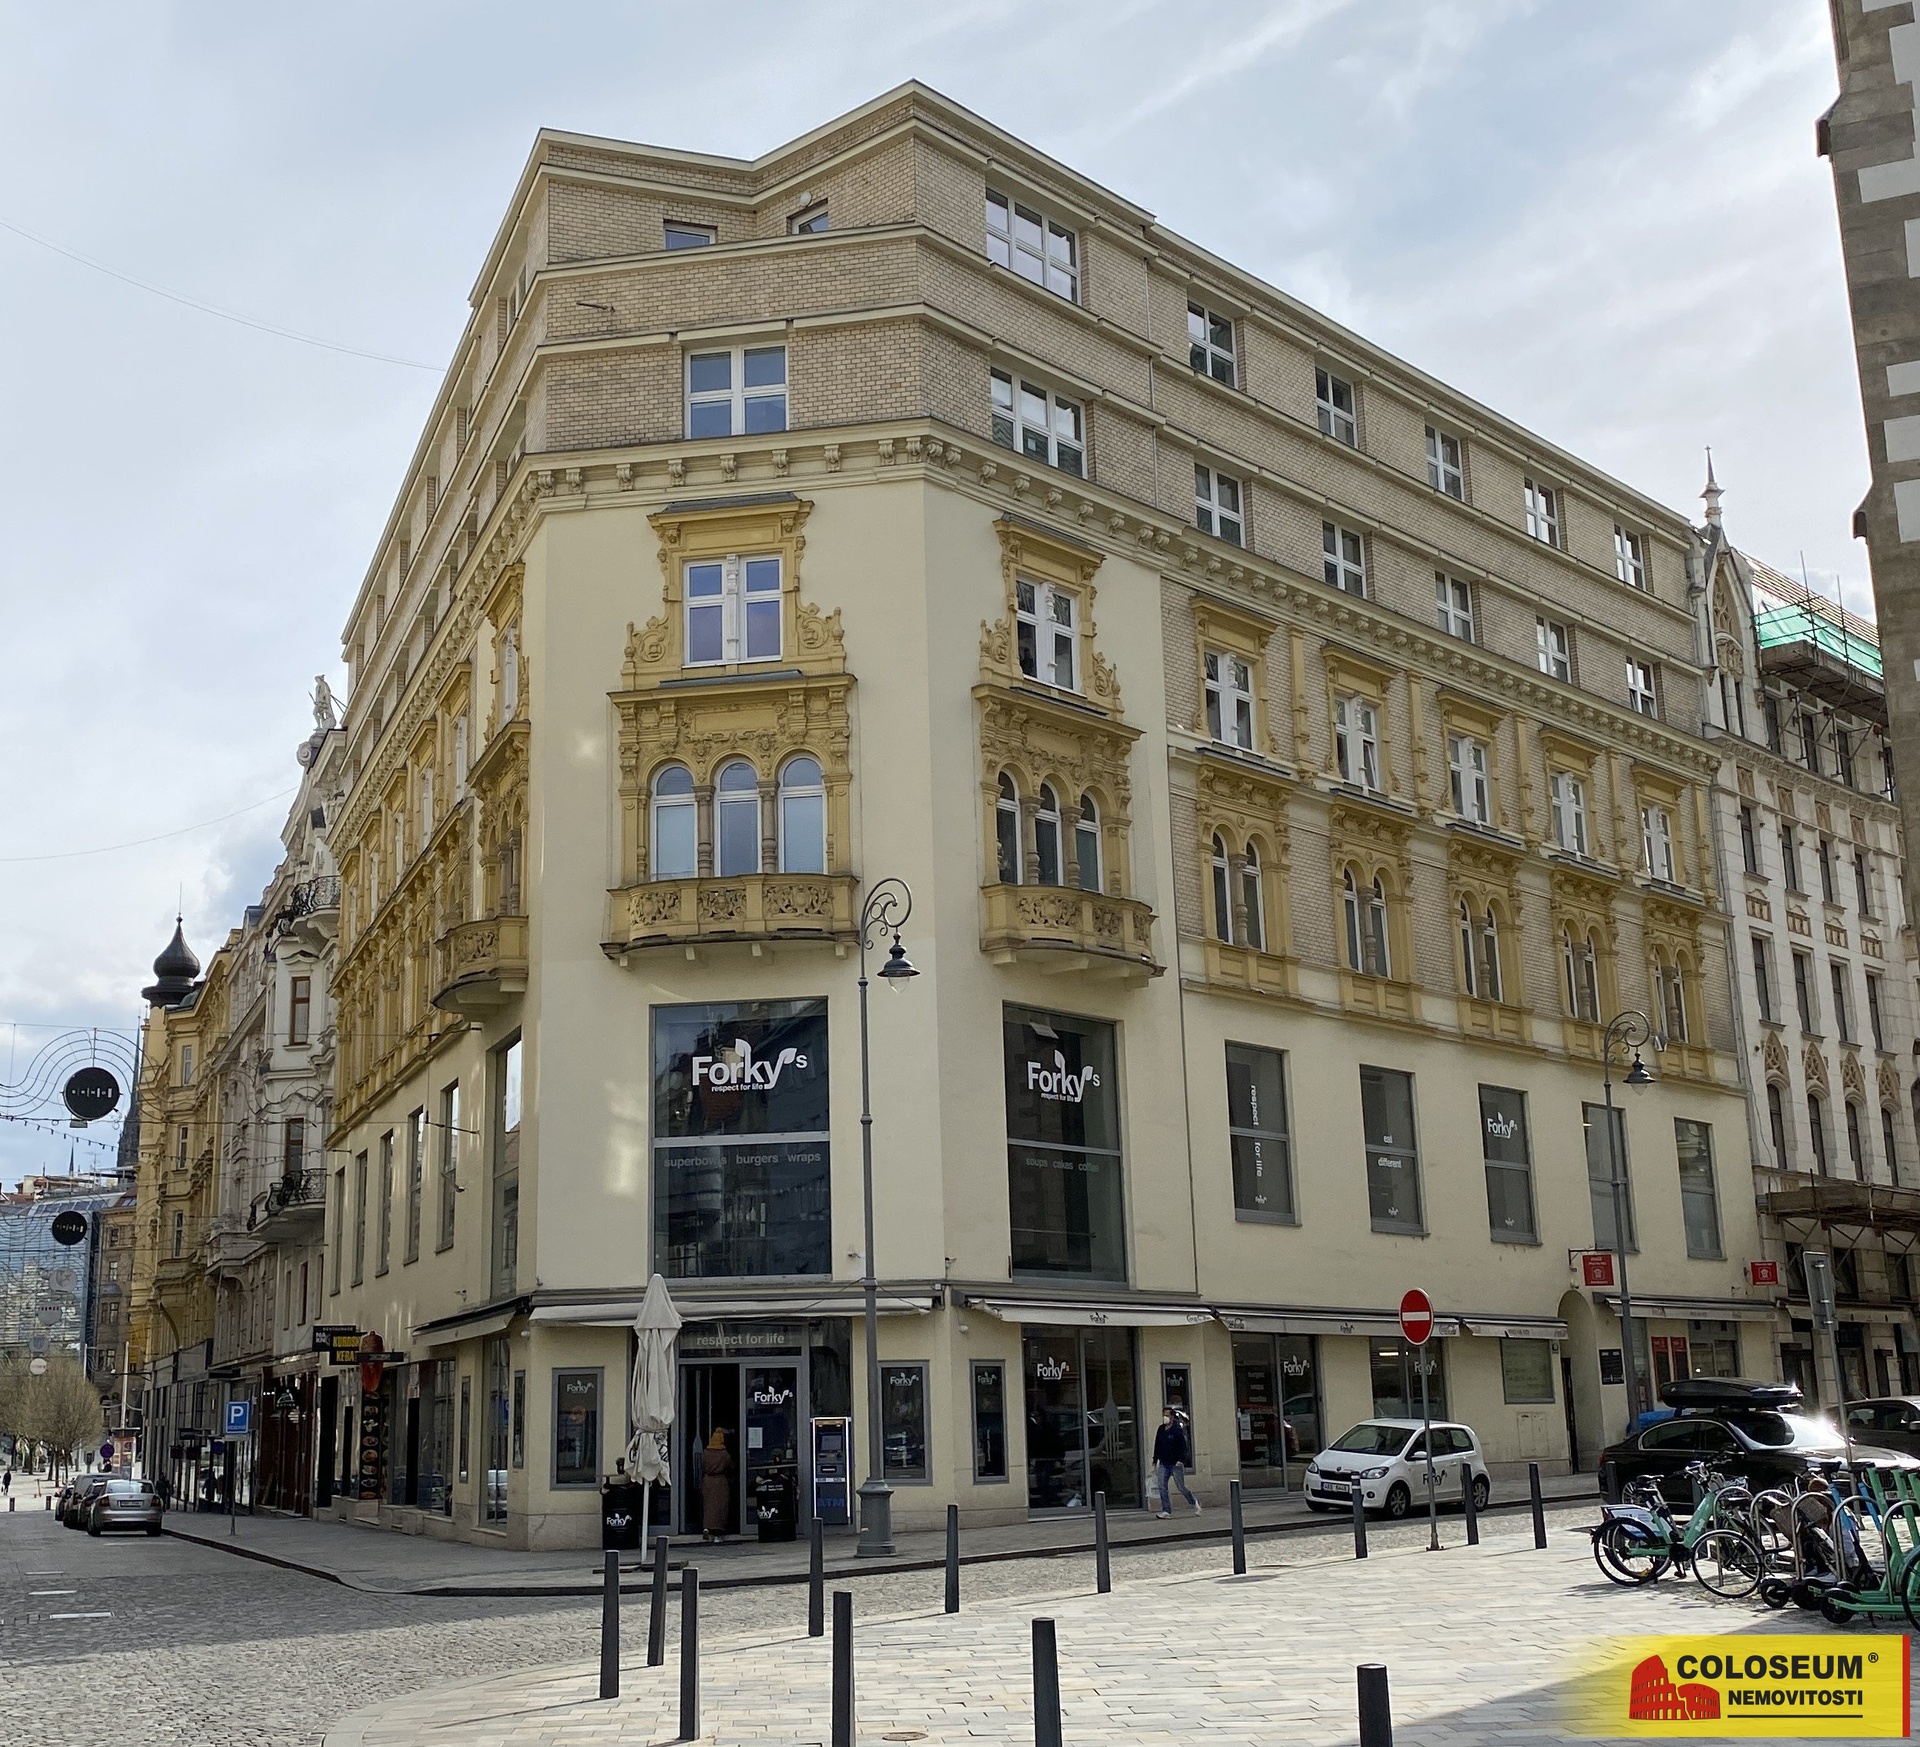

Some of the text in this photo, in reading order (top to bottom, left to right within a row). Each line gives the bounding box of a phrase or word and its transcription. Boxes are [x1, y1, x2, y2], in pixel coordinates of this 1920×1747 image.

[711, 1084, 739, 1092] respect
[1250, 1085, 1259, 1125] respect
[1383, 1135, 1393, 1144] eat
[736, 1153, 779, 1166] burgers
[787, 1152, 821, 1164] wraps
[1025, 1157, 1048, 1169] soups
[1053, 1159, 1073, 1170] cakes
[1378, 1157, 1402, 1168] different
[696, 1332, 785, 1347] respect for life
[231, 1405, 244, 1424] P
